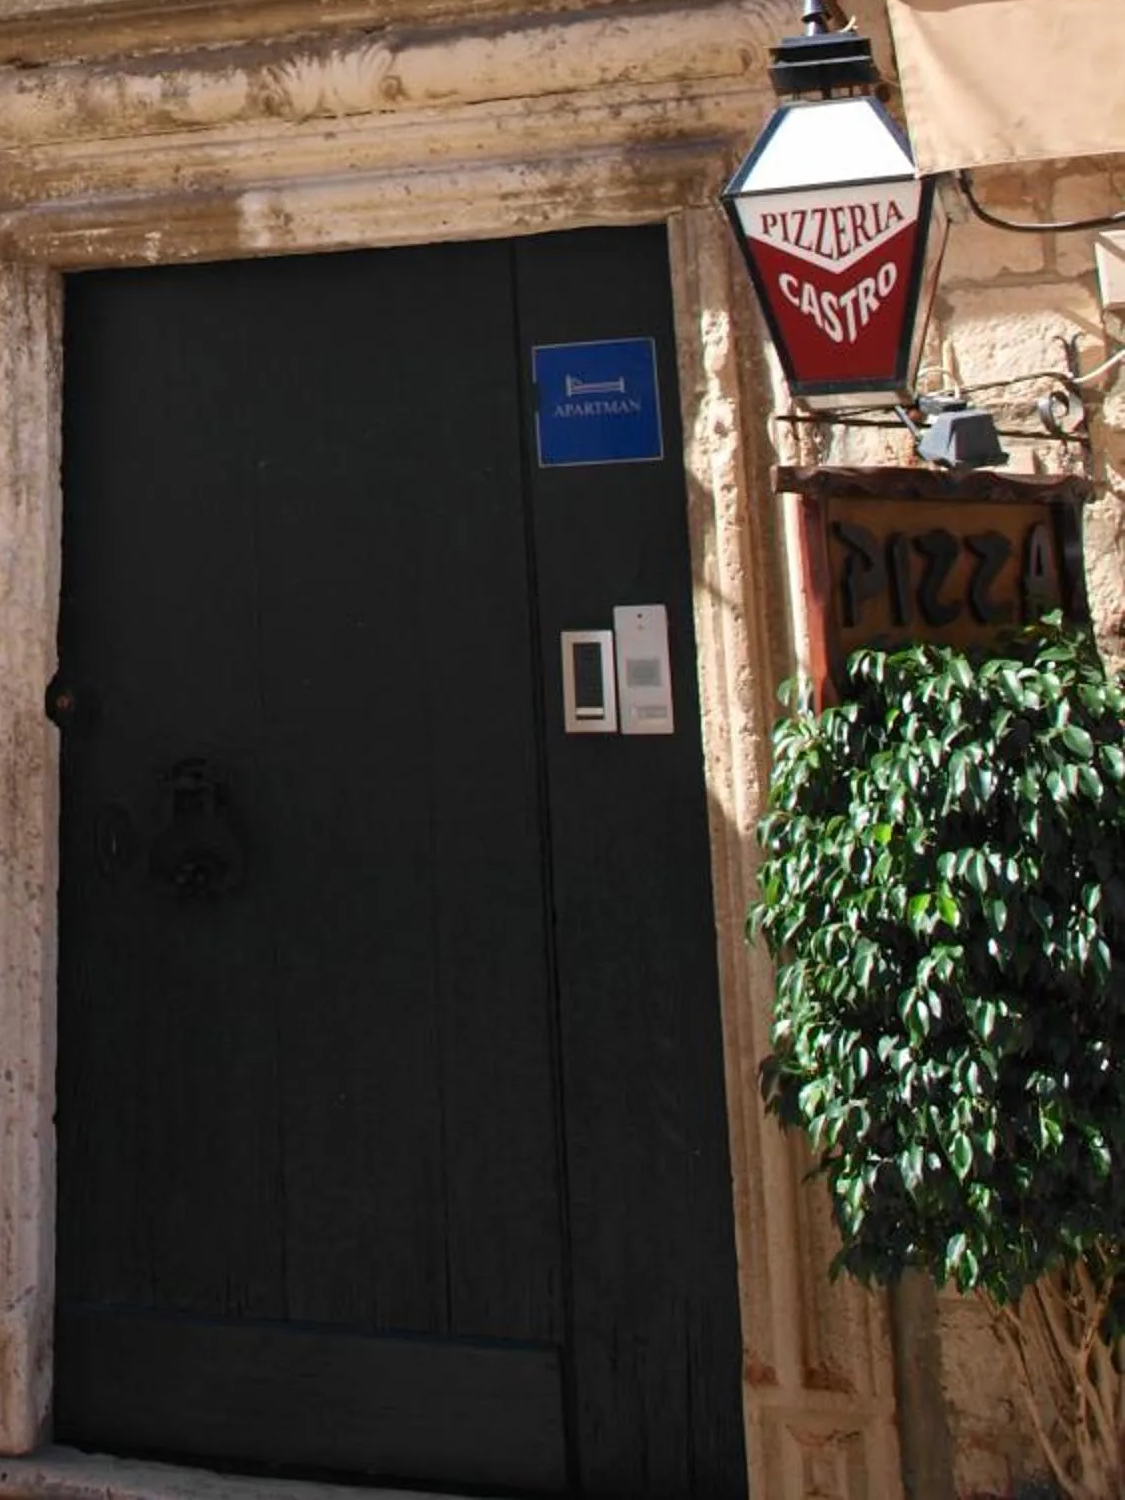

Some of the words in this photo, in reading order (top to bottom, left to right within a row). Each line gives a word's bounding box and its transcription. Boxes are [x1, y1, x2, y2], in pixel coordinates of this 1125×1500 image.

[760, 200, 904, 260] PIZZERIA
[778, 261, 898, 344] CASTRO
[555, 398, 642, 418] APARTMAN
[831, 520, 1065, 628] PIZZA
